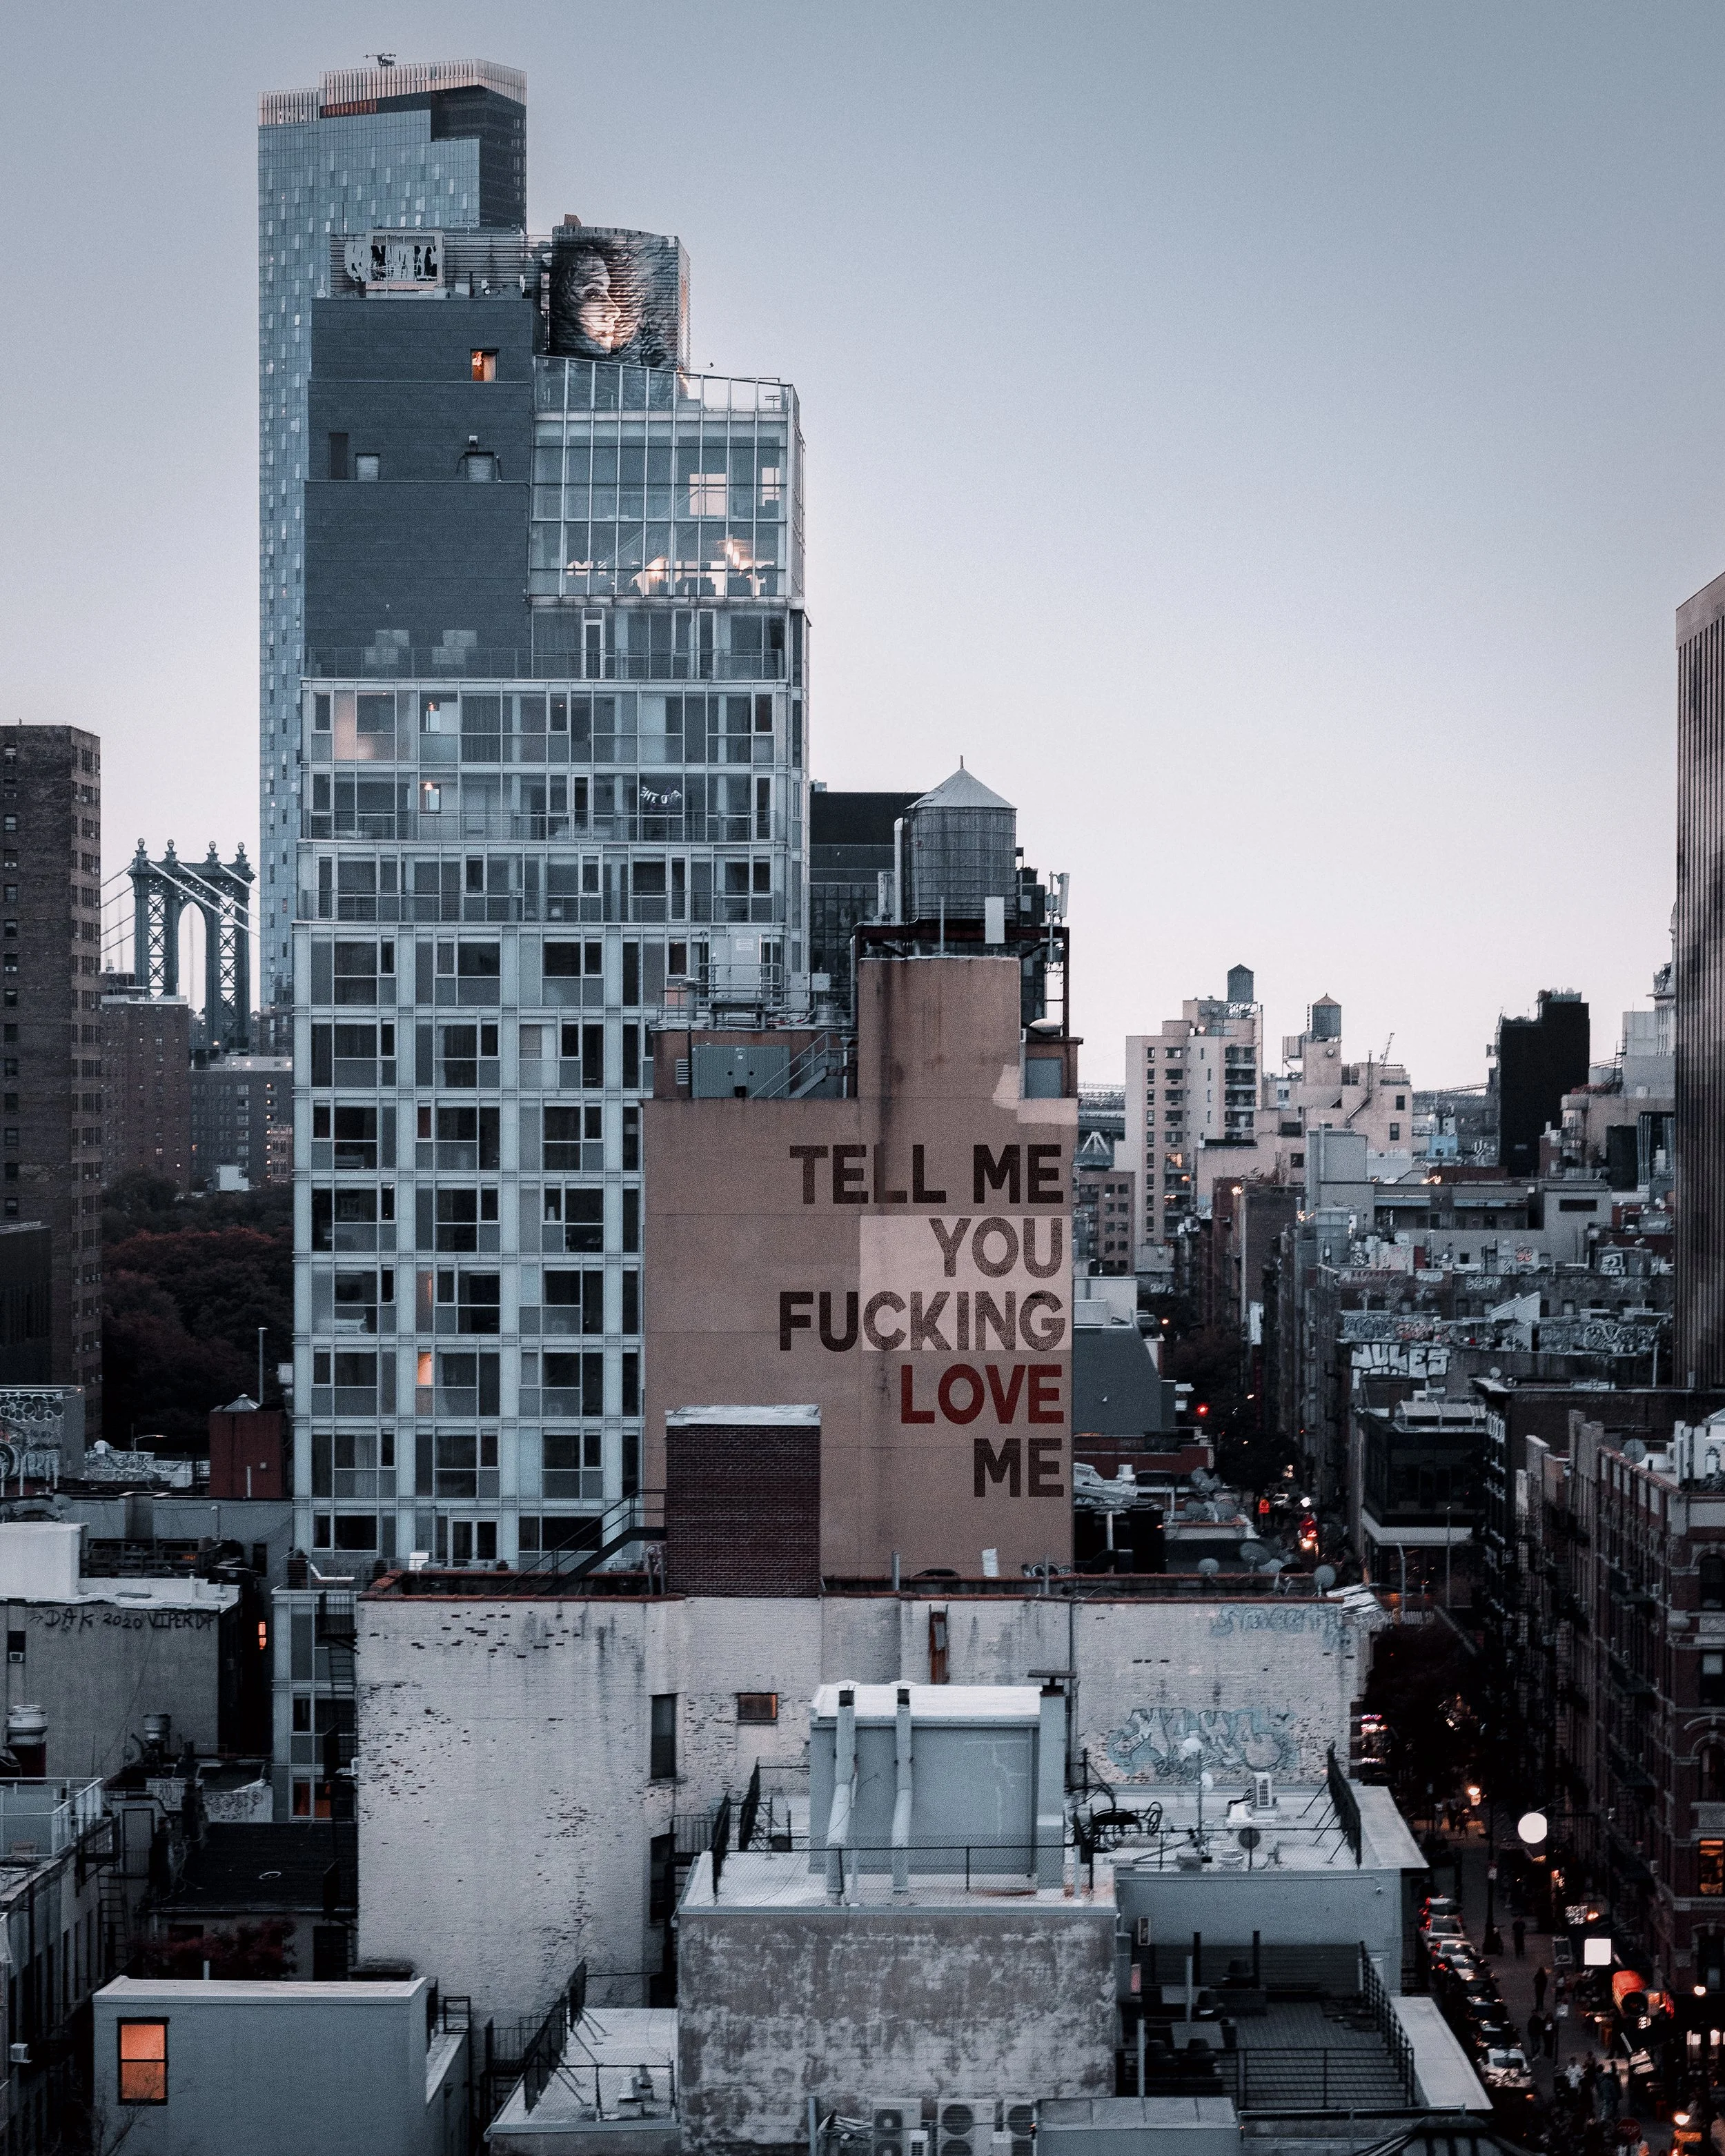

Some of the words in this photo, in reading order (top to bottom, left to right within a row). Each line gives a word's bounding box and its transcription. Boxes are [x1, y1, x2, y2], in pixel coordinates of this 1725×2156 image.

[789, 1144, 947, 1204] TELL
[973, 1144, 1064, 1204] ME
[929, 1216, 1063, 1278] YOU
[779, 1290, 1066, 1352] FUCKING
[900, 1363, 1064, 1425] LOVE
[974, 1438, 1064, 1498] ME
[102, 1612, 143, 1630] 2020
[146, 1612, 194, 1629] VIPER
